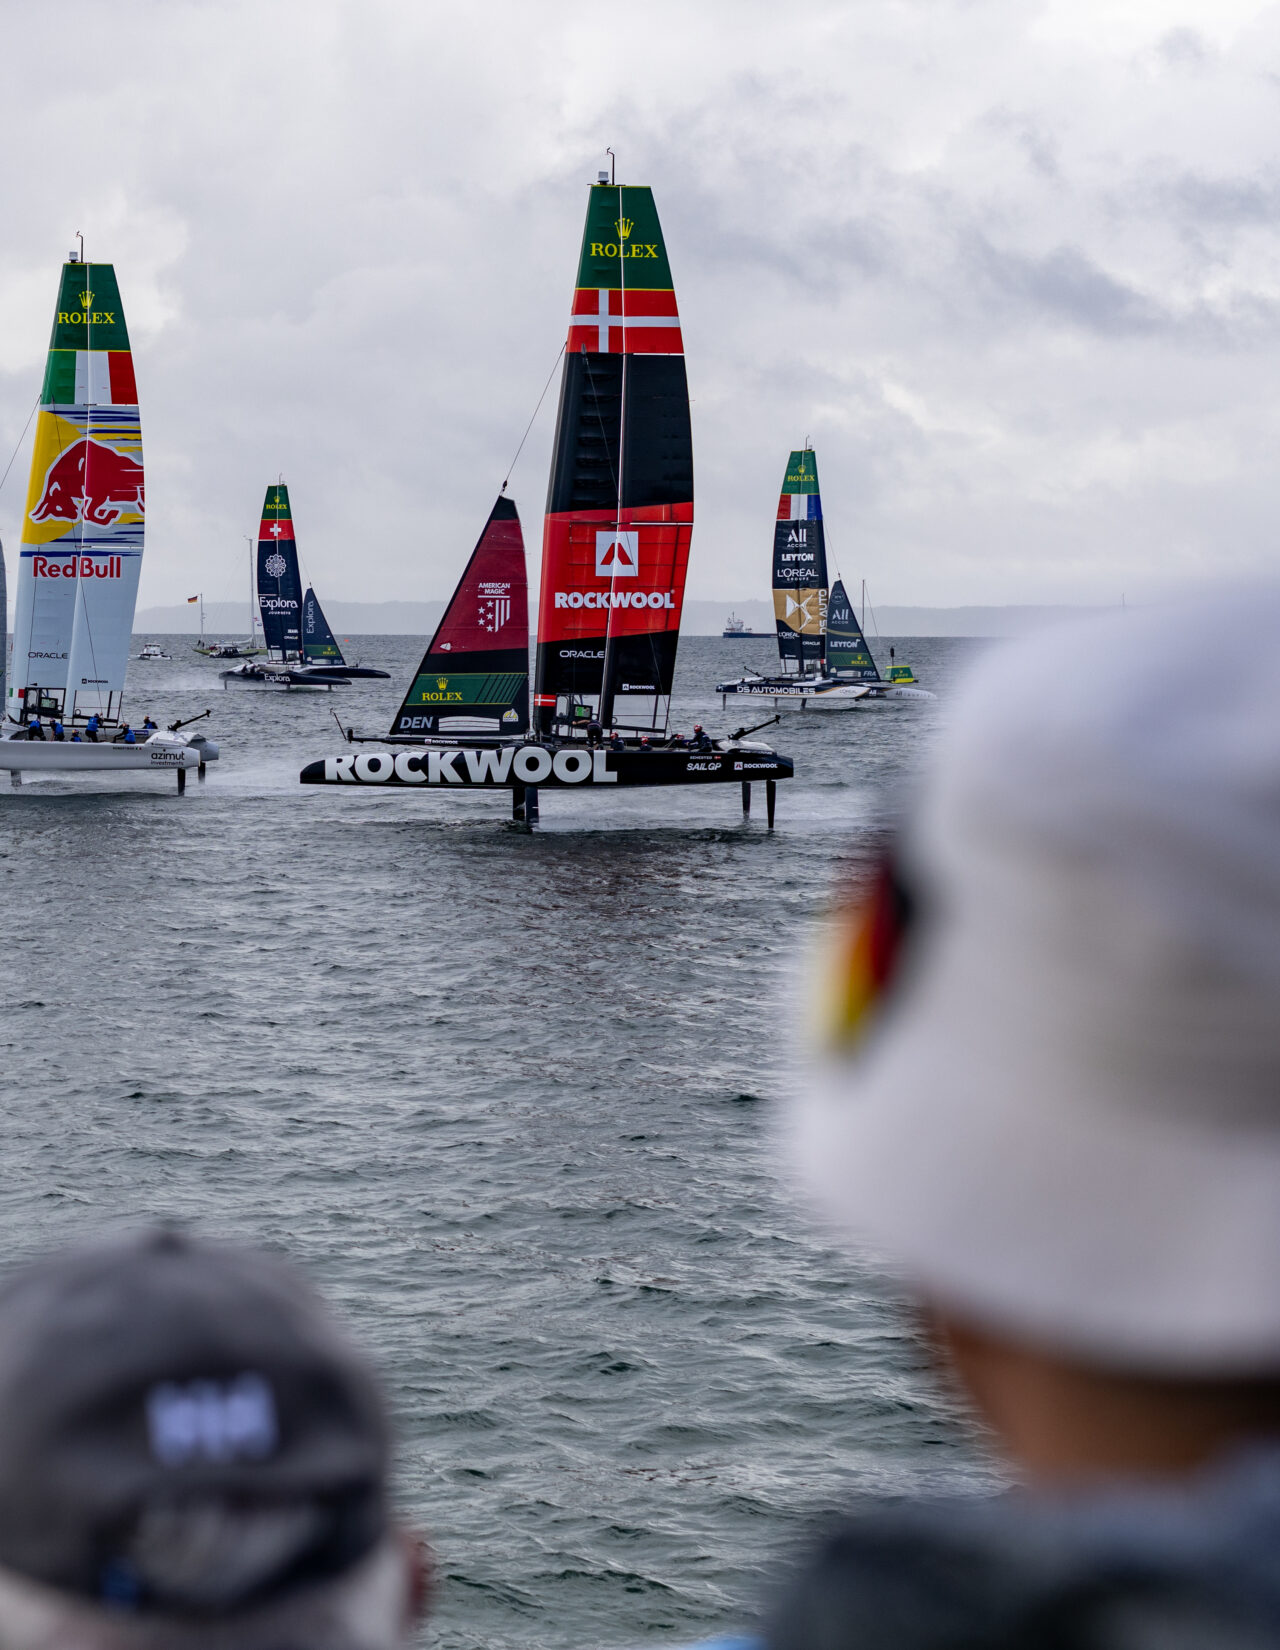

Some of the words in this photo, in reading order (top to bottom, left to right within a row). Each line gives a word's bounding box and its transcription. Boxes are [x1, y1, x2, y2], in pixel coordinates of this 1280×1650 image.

[590, 243, 659, 258] ROLEX
[58, 312, 115, 324] ROLEX
[787, 529, 807, 543] All
[781, 553, 814, 562] LEYTON
[260, 597, 299, 610] Explora
[554, 591, 675, 609] ROCKWOOL
[306, 600, 316, 634] Explora
[832, 609, 849, 621] All
[830, 640, 857, 648] LEYTON
[28, 651, 68, 659] ORACLE
[559, 650, 605, 659] ORACLE
[264, 673, 291, 683] Explora
[422, 692, 463, 701] ROLEX
[751, 686, 816, 695] AUTOMOBILES
[400, 716, 433, 729] DEN
[151, 748, 185, 760] azimut
[325, 746, 618, 783] ROCKWOOL
